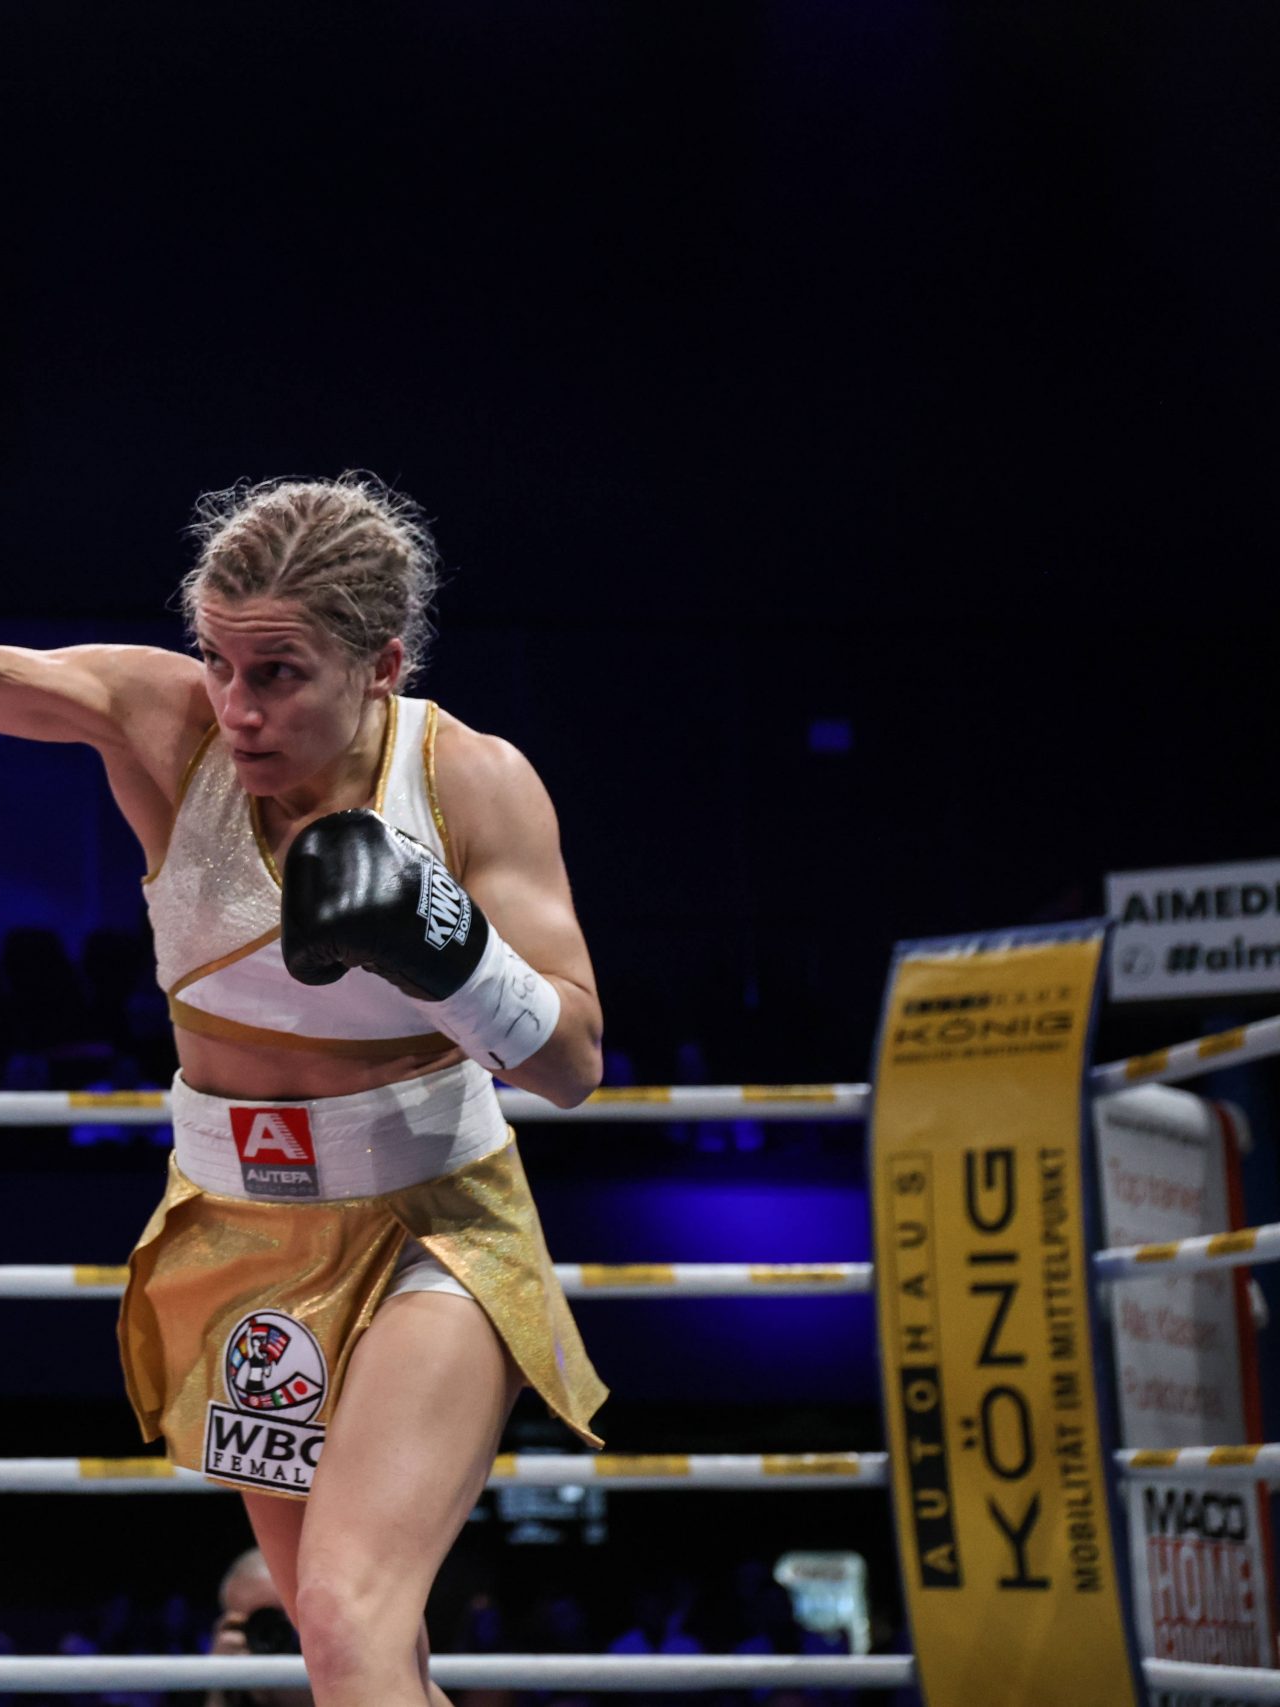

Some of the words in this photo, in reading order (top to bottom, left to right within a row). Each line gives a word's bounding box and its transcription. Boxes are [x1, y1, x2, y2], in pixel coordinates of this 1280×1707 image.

[1039, 1146, 1077, 1360] MITTELPUNKT
[215, 1416, 326, 1467] WBC
[897, 1170, 957, 1574] AUTOHAUS
[961, 1147, 1050, 1591] KÖNIG
[1051, 1373, 1080, 1414] IM
[213, 1452, 306, 1484] FEMAL
[1053, 1422, 1101, 1592] MOBILITÄT
